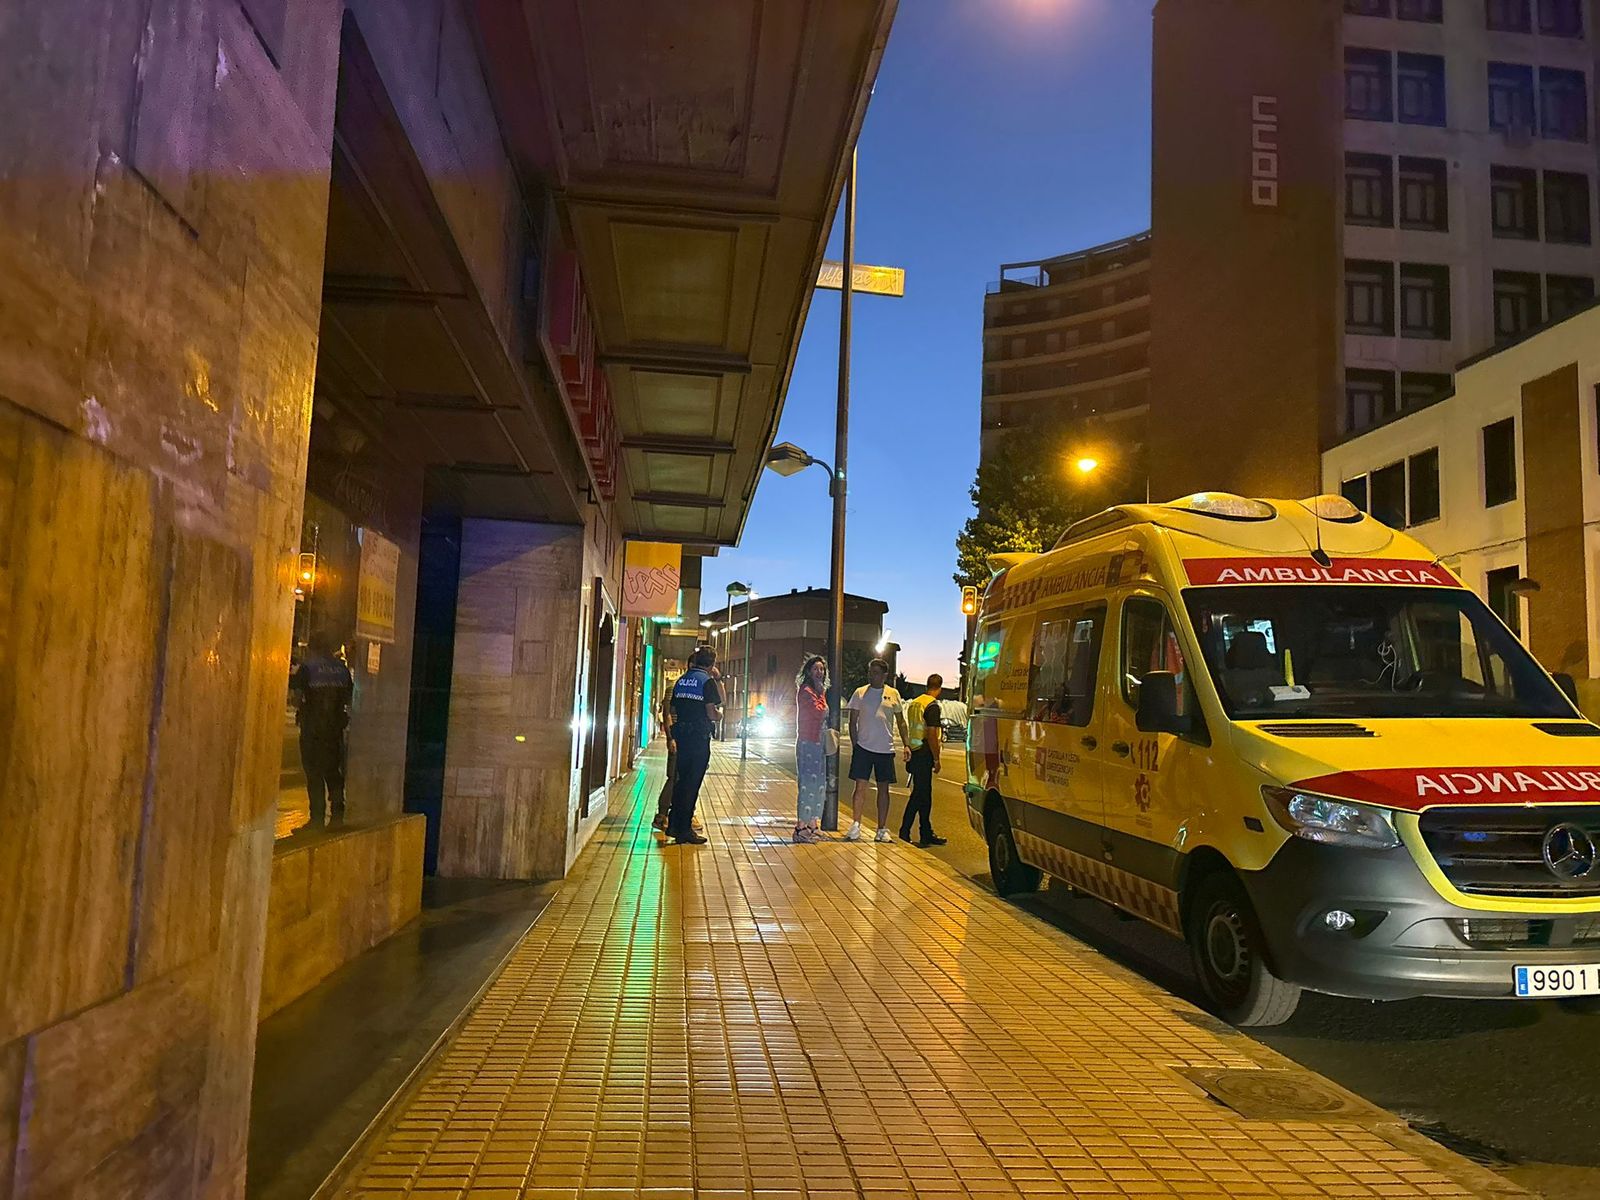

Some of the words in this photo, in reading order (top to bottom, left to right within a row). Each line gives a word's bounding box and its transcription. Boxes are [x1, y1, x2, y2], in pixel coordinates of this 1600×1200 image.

[1252, 95, 1278, 206] CCOO
[1040, 567, 1106, 598] AMBULANCIA
[1217, 567, 1443, 584] AMBULANCIA
[1138, 739, 1159, 771] 112
[1533, 969, 1586, 991] 9901
